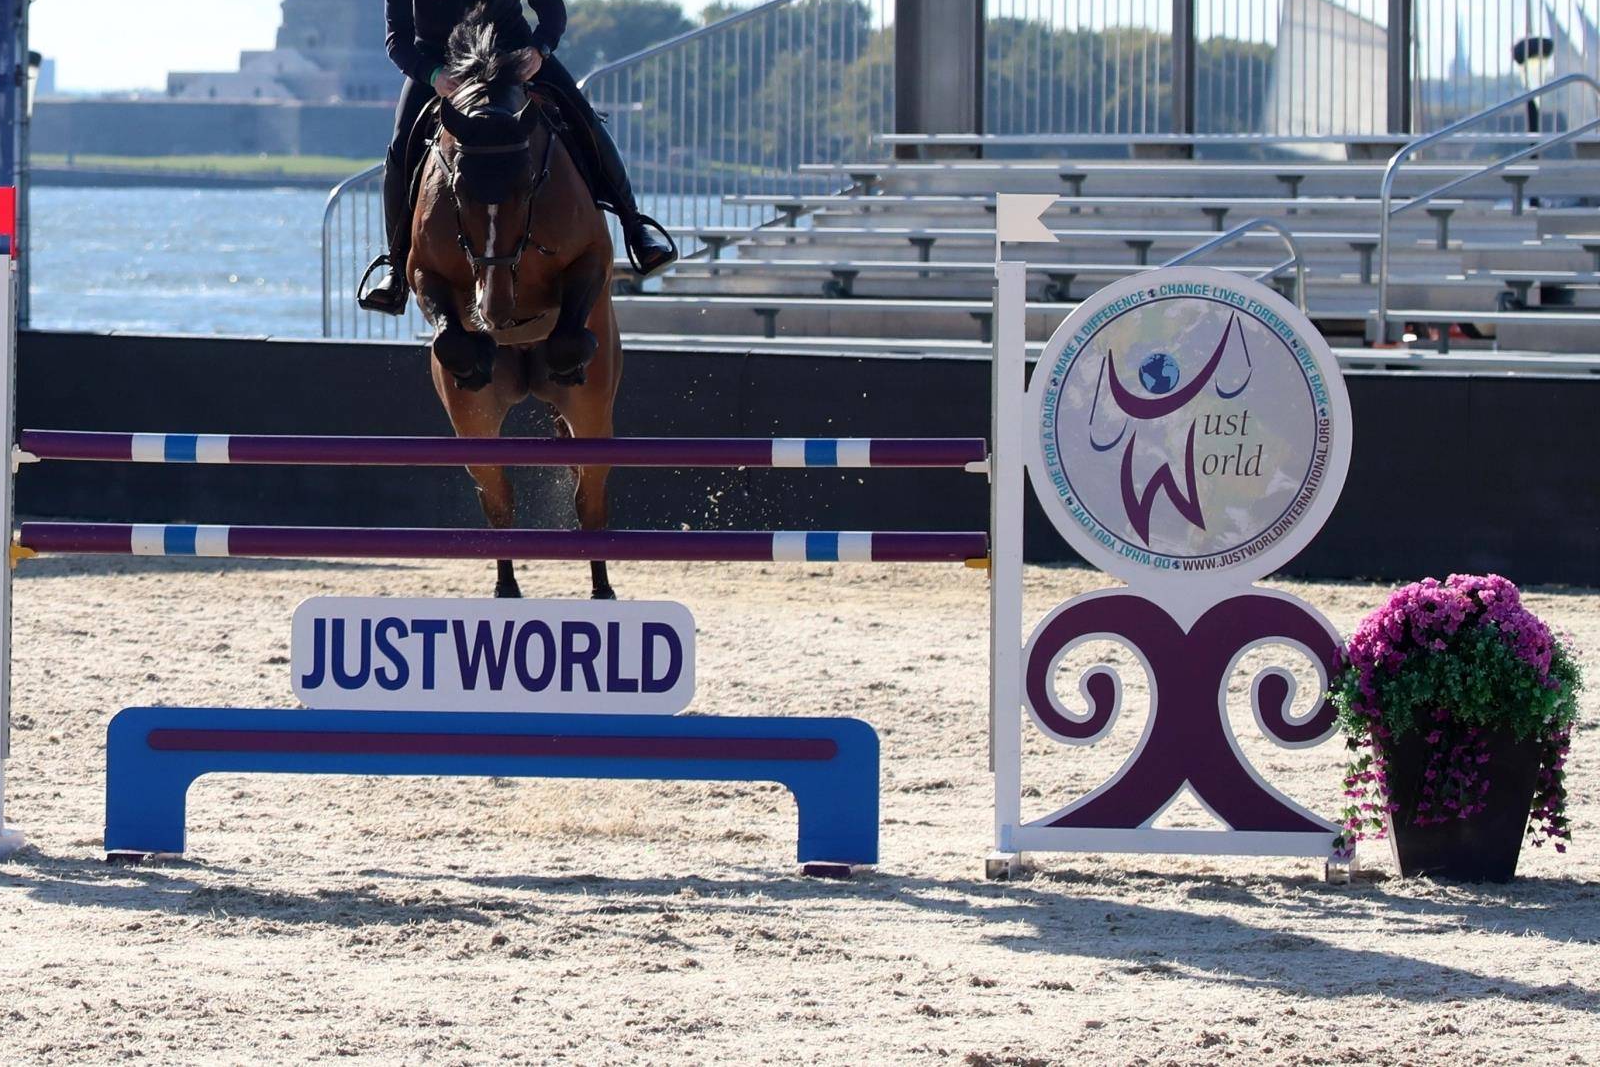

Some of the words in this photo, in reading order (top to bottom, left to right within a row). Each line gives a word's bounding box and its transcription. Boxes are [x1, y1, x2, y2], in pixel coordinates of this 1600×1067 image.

[1160, 285, 1212, 296] CHANGE
[1213, 287, 1246, 306] LIVES
[1246, 300, 1294, 340] FOREVER
[1053, 342, 1077, 376] MAKE
[1073, 335, 1084, 345] A
[1081, 290, 1146, 335] DIFFERENCE
[1296, 348, 1316, 373] GIVE
[1309, 374, 1328, 407] BACK
[1043, 388, 1058, 431] CAUSE
[1043, 434, 1054, 445] A
[1043, 447, 1057, 466] FOR
[1050, 469, 1069, 497] RIDE
[1182, 418, 1330, 571] WWW.JUSTWORLDINTERNATIONAL.ORG
[1071, 504, 1096, 531] LOVE
[1094, 529, 1115, 550] YOU
[1117, 544, 1151, 565] WHAT
[1154, 557, 1171, 569] DO
[302, 616, 683, 693] JUSTWORLD
